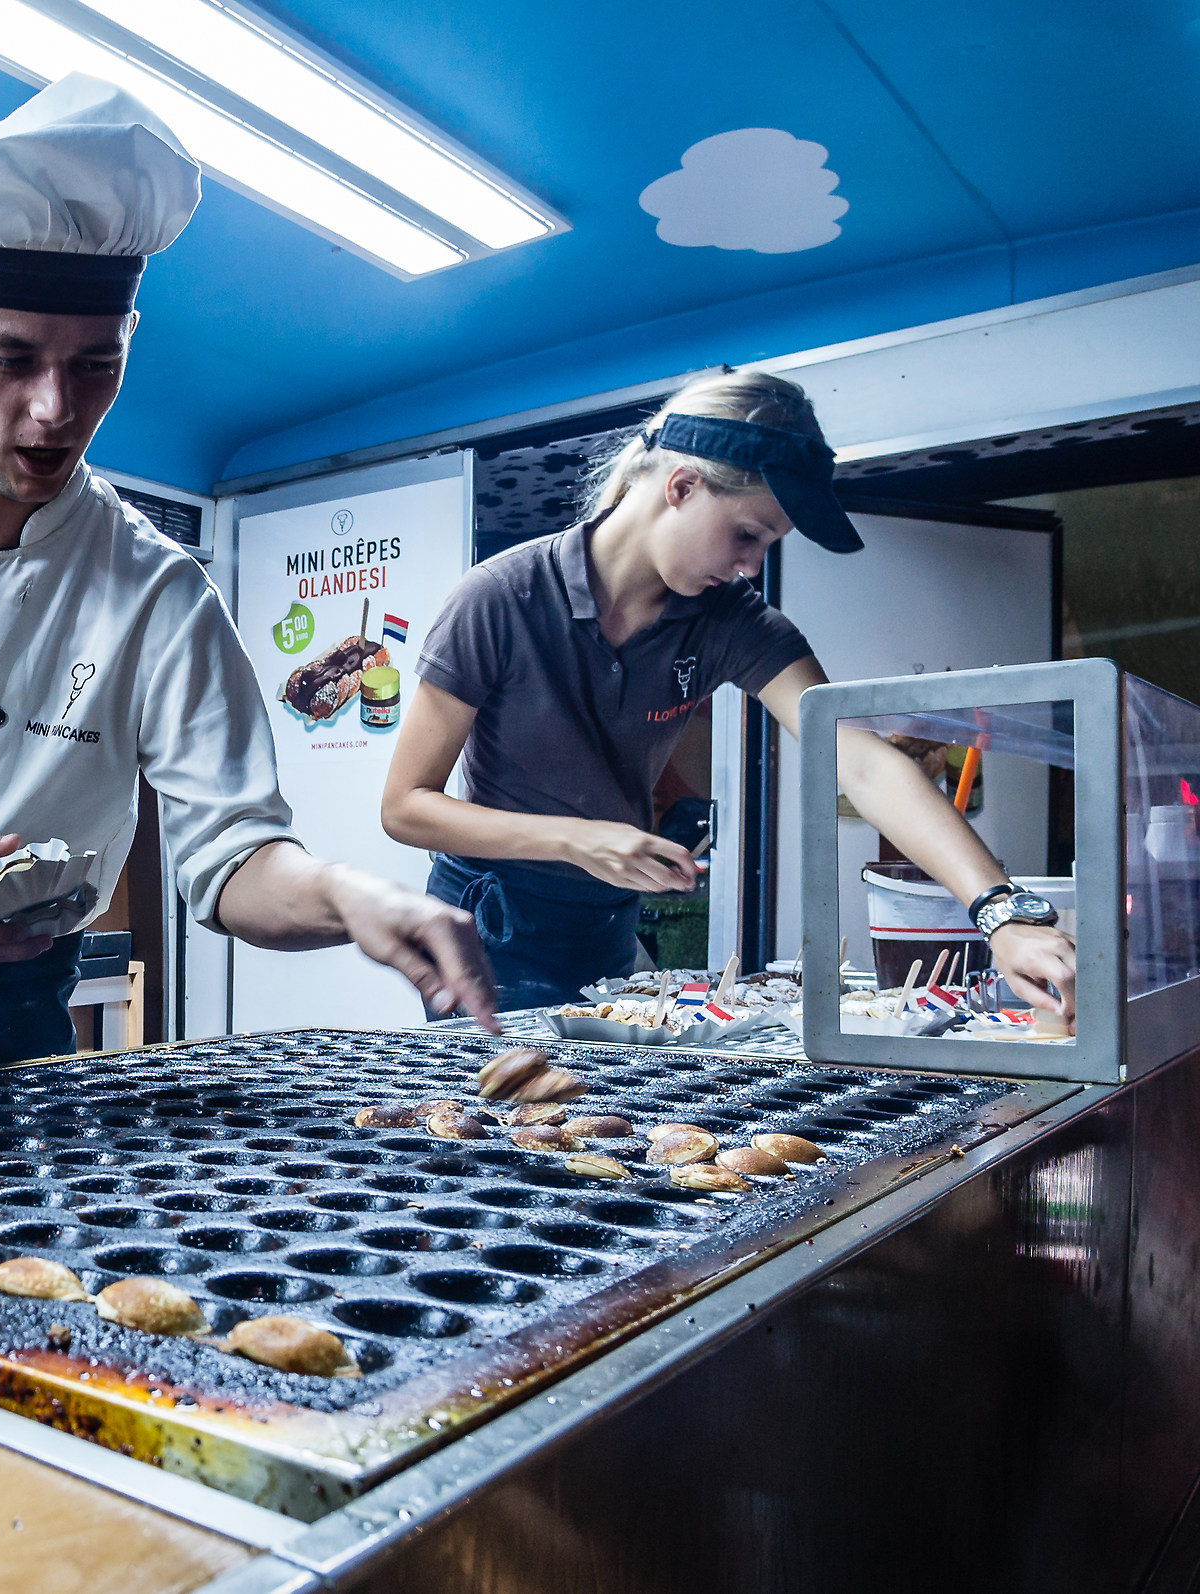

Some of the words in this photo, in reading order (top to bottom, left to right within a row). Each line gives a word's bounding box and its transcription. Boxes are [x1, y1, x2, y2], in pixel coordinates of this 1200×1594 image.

[286, 549, 325, 576] MINI
[331, 537, 401, 570] CRÊPES
[298, 567, 387, 599] OLANDESI
[25, 720, 50, 736] MINI
[311, 740, 368, 750] MINIPANCAKES.COM
